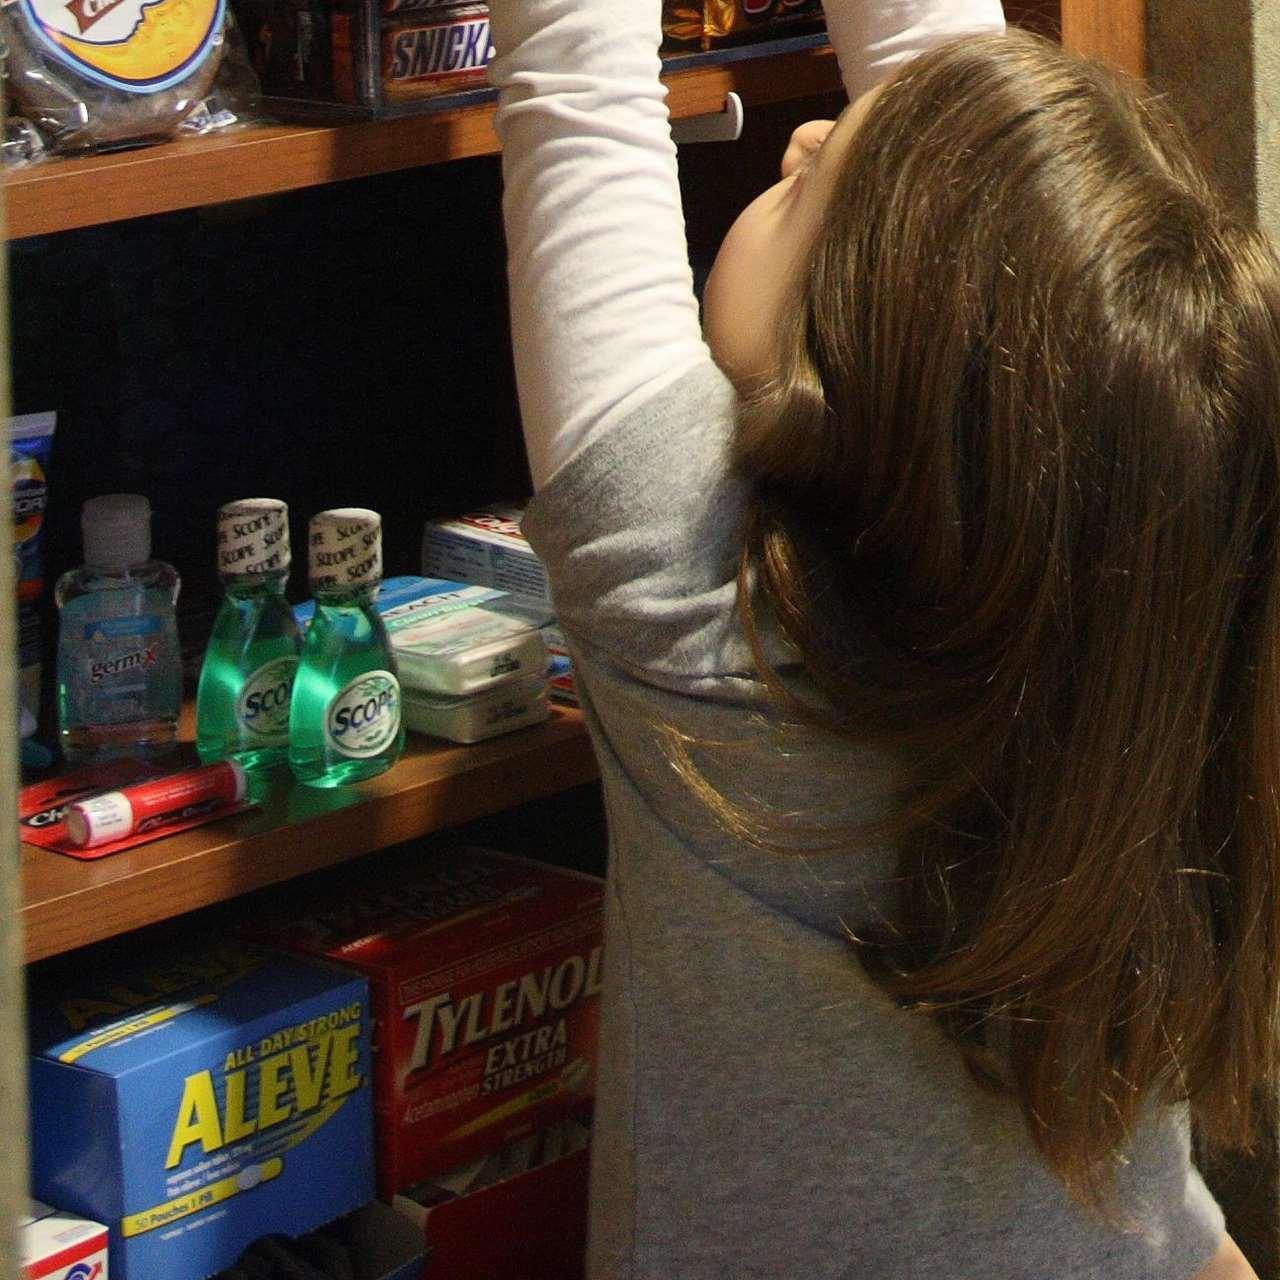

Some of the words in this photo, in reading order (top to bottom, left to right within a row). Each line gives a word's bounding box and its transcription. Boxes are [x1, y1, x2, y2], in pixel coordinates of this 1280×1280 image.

[243, 679, 293, 720] SCO
[333, 684, 395, 737] SCOPE
[224, 1047, 255, 1073] ALL
[260, 1030, 293, 1058] DAY
[293, 1000, 363, 1042] STRONG
[487, 1017, 569, 1075] EXTRA
[164, 1024, 363, 1171] ALEVE
[483, 1050, 567, 1097] STRENGTH
